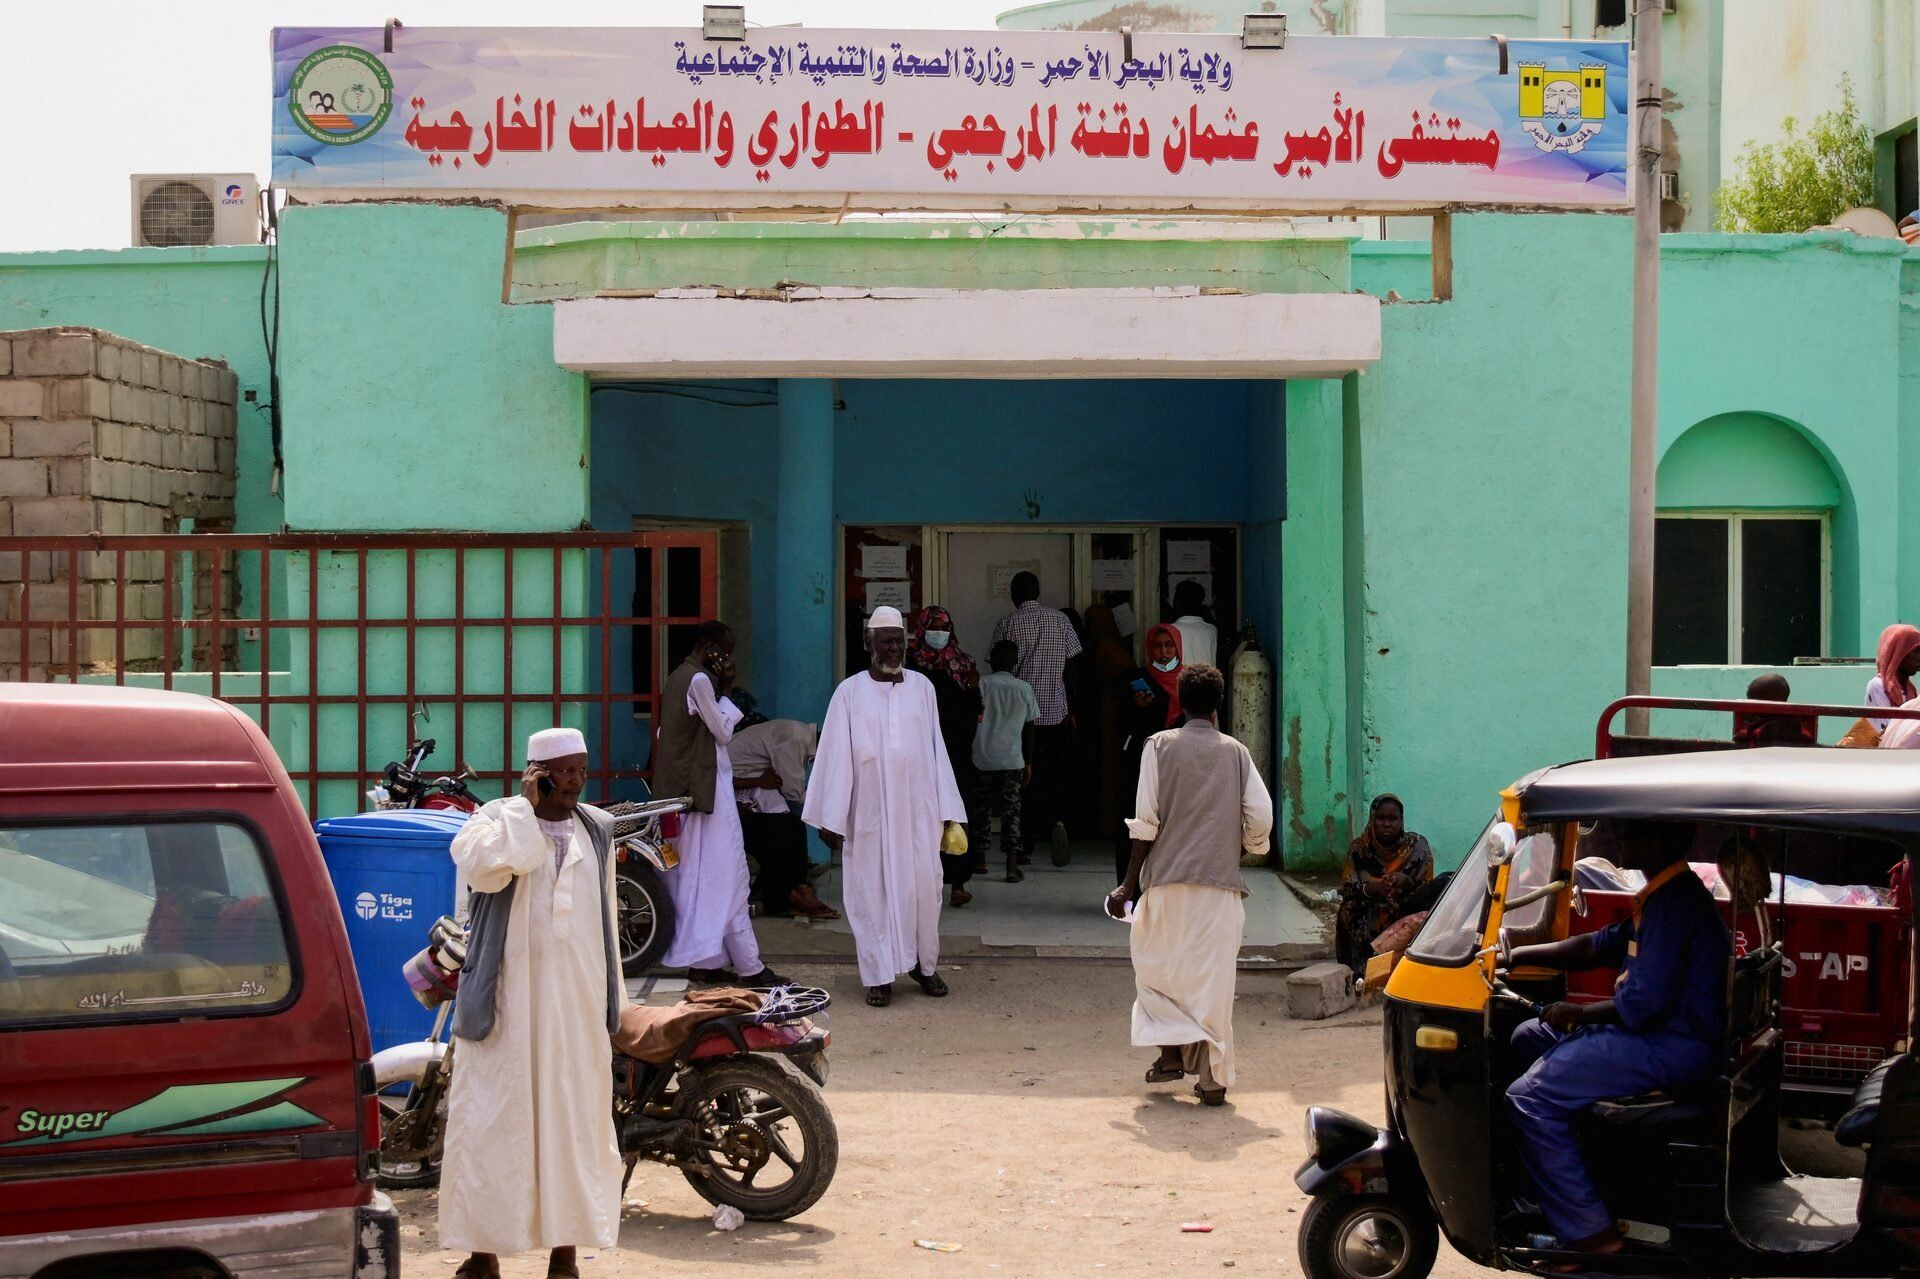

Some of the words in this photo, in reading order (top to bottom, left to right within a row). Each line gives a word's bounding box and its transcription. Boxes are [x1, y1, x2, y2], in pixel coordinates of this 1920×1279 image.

[674, 40, 793, 86] الإجتماعية
[799, 42, 887, 85] والتنمية
[891, 42, 960, 77] الصحة
[964, 46, 1016, 86] وزارة
[1040, 43, 1111, 87] الأحمر
[1114, 50, 1174, 89] البحر
[1179, 47, 1233, 93] ولاية
[404, 94, 557, 168] الخارجية
[568, 97, 736, 168] والعيادات
[747, 98, 885, 182] الطواري
[926, 103, 1059, 181] المرجعي
[1071, 102, 1151, 158] دقنة
[1162, 104, 1260, 175] عثمان
[1273, 92, 1367, 178] الأمير
[1376, 110, 1502, 179] مستشفى
[380, 893, 413, 907] Tiga
[381, 906, 413, 922] تيقا
[17, 1109, 110, 1136] Super
